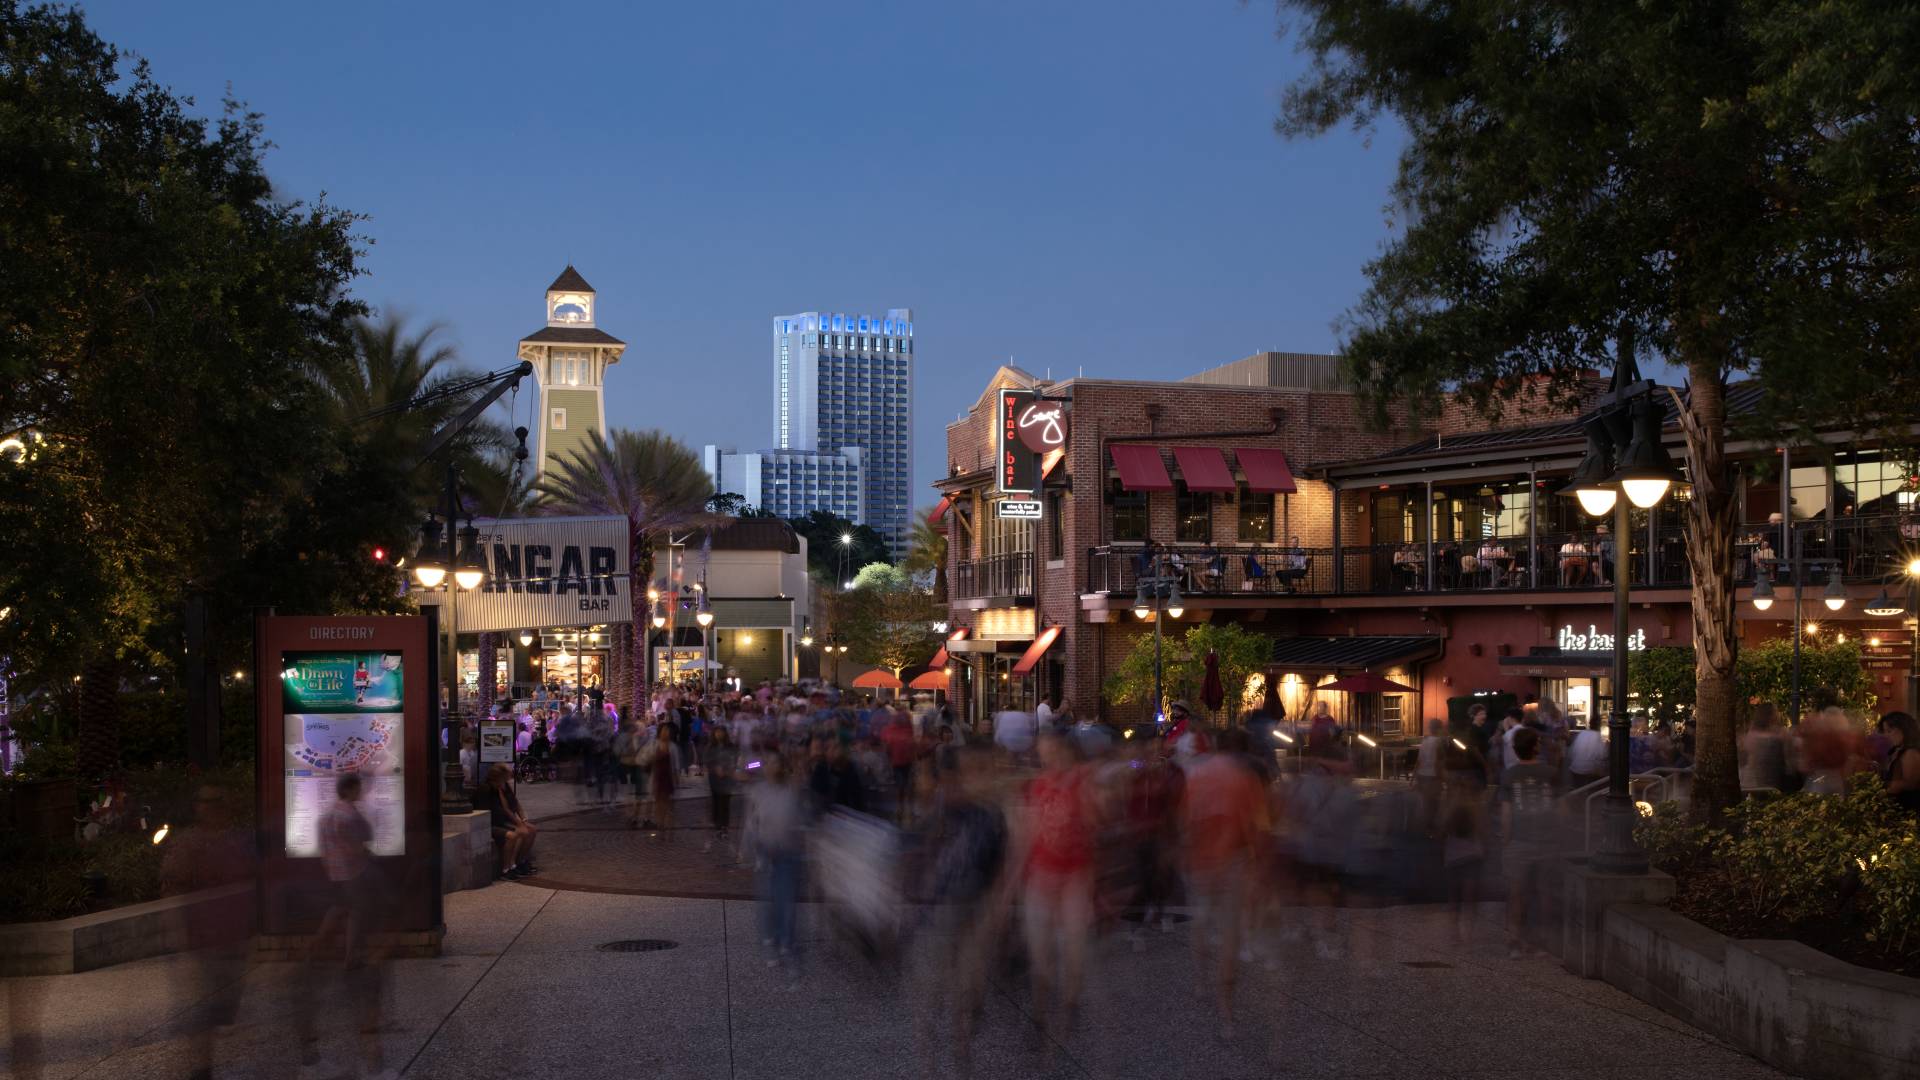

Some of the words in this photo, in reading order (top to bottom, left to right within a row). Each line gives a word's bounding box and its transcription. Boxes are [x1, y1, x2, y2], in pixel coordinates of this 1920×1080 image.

[1006, 451, 1016, 486] bar
[456, 544, 617, 595] NGAR
[579, 599, 610, 611] BAR
[310, 627, 376, 640] DIRECTORY
[1558, 624, 1587, 650] the
[1588, 624, 1646, 650] baset
[301, 668, 345, 680] Drawn
[318, 679, 343, 690] Life
